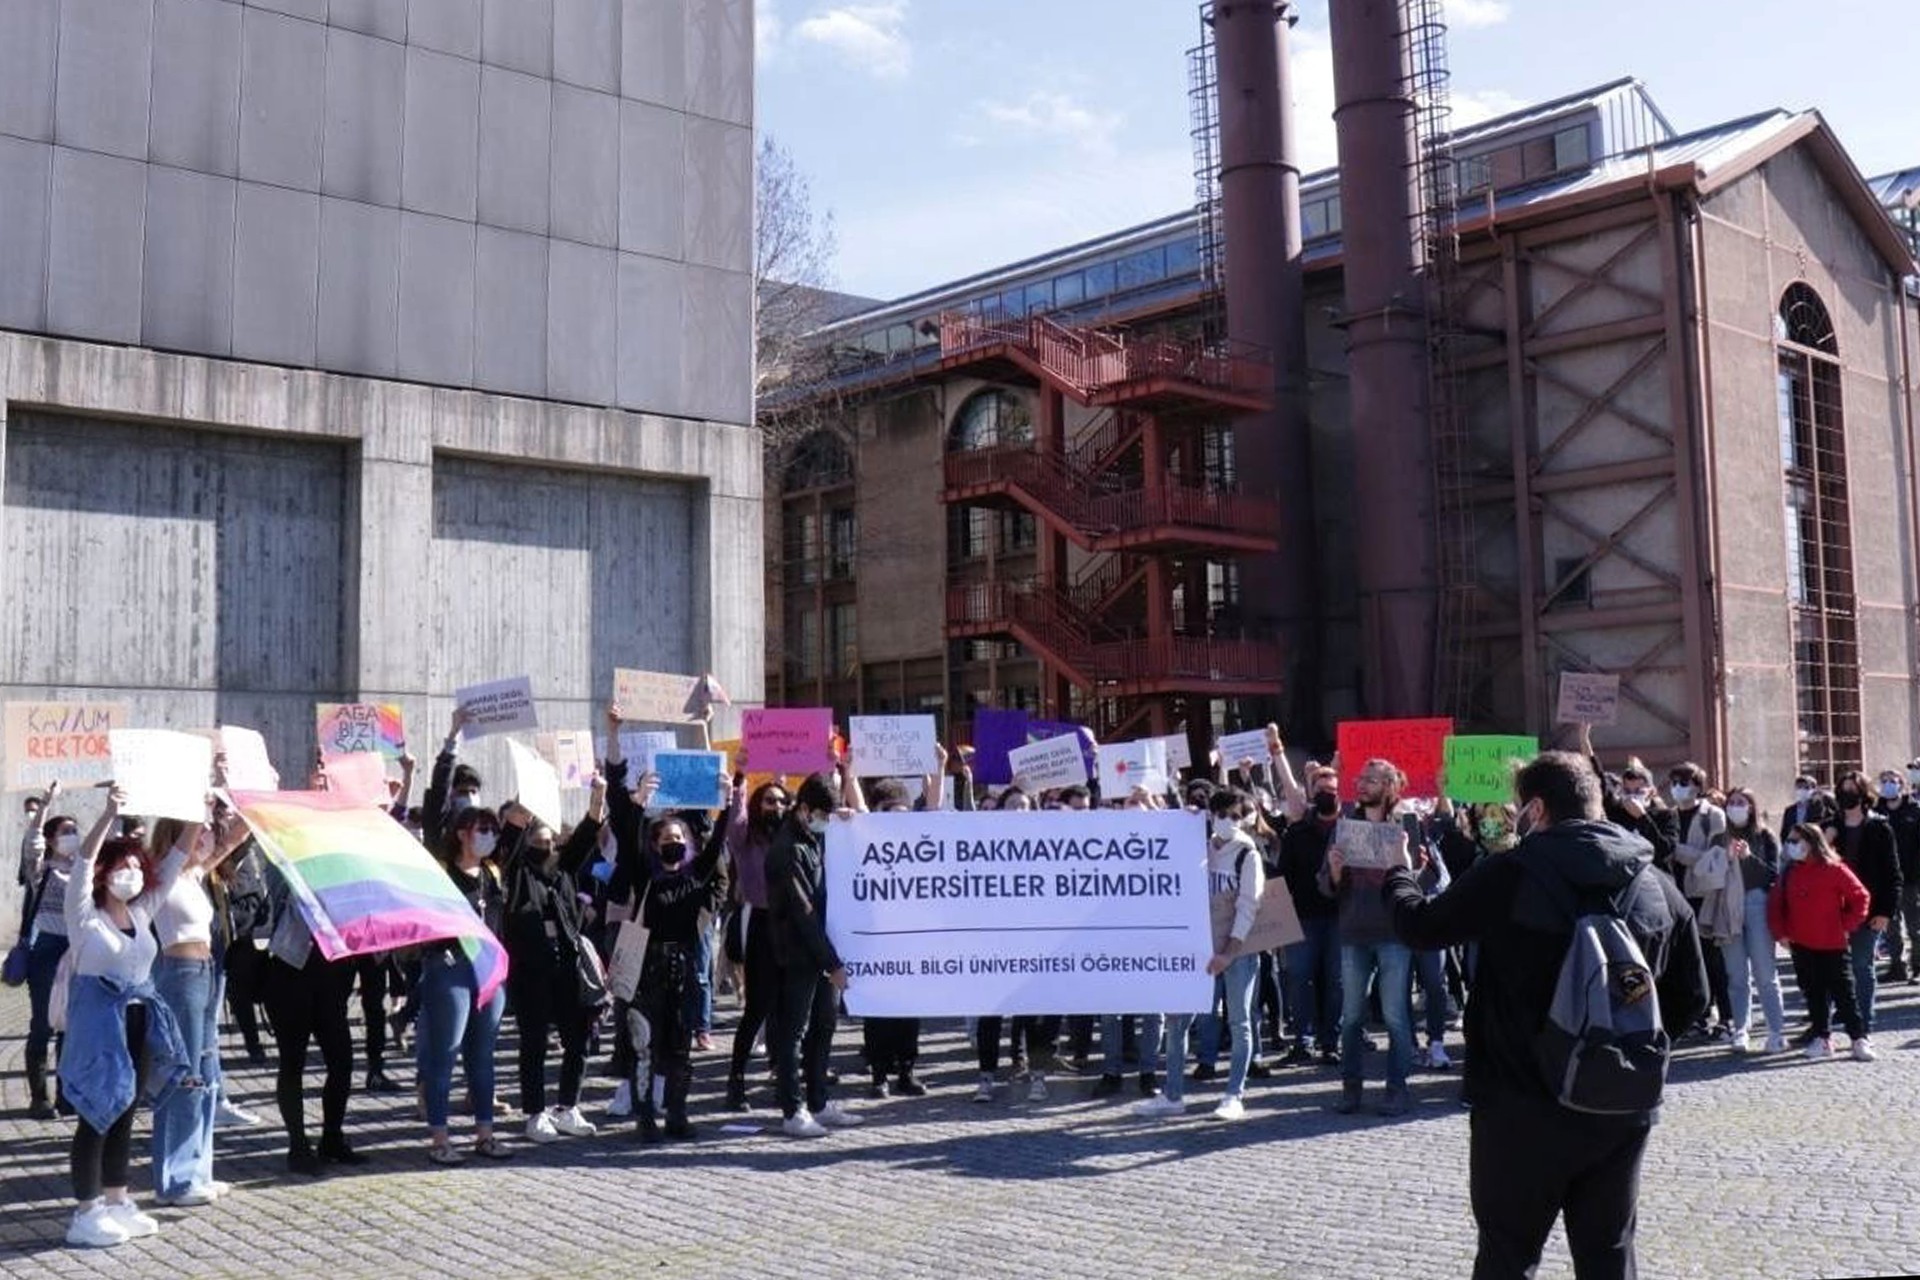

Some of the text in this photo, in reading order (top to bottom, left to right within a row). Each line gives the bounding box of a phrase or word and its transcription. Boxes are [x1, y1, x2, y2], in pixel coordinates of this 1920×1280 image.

[862, 833, 1170, 870] AŞAĞI BAKMAYACAĞIZ
[852, 869, 1044, 902] ÜNİVERSİTELER
[1055, 868, 1181, 897] BİZİMDİR!
[845, 952, 1195, 977] STANBUL BİLGİ ÜNİVERSİTESİ ÖĞRENCİLERİ
